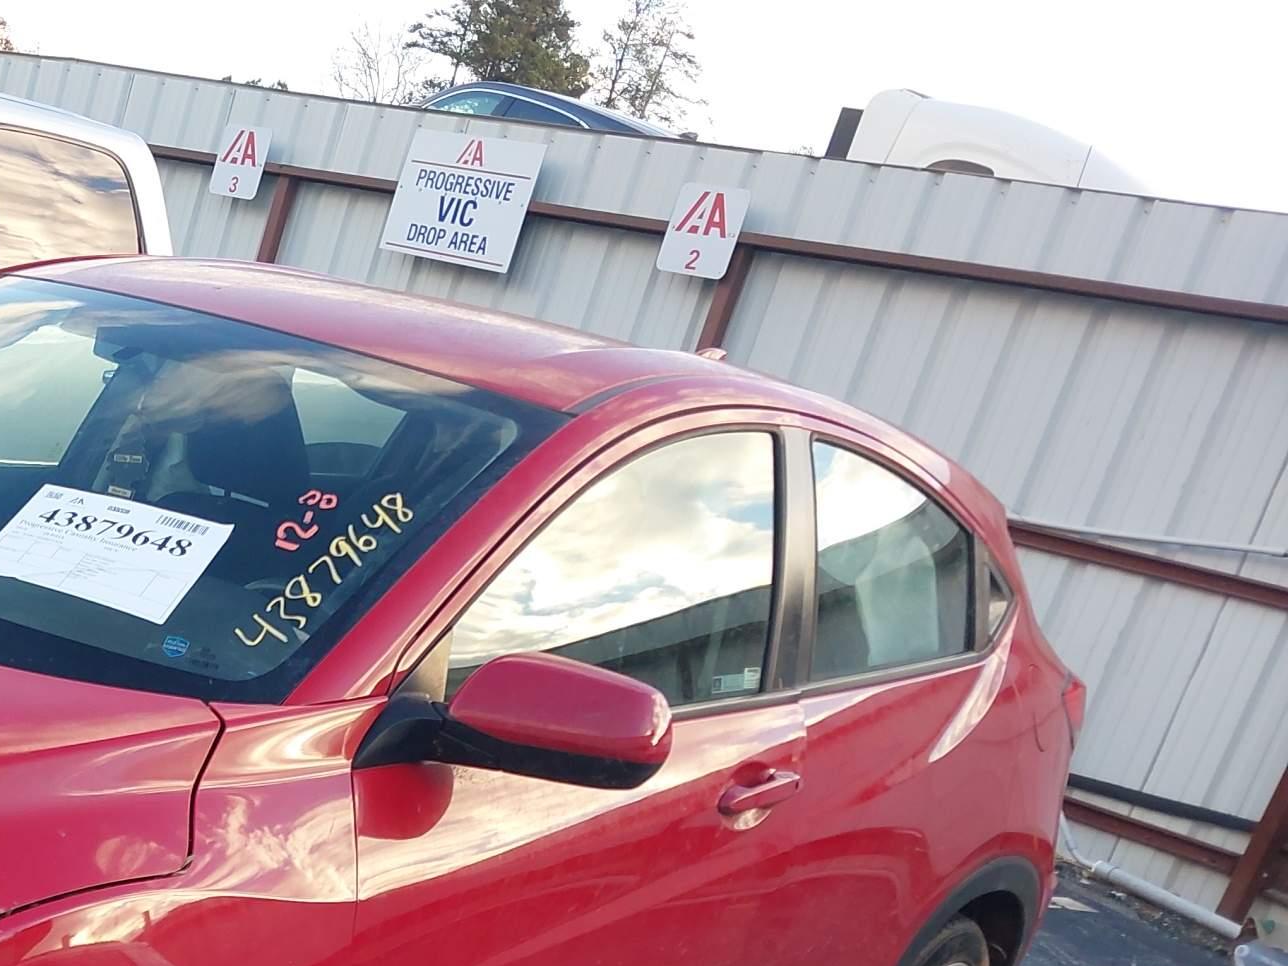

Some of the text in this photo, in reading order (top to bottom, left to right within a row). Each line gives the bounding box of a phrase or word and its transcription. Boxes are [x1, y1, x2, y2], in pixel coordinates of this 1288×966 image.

[228, 176, 239, 193] 3
[416, 168, 516, 202] PROGRESSIVE
[438, 195, 478, 228] VIC
[406, 223, 488, 256] DROP AREA
[684, 249, 701, 270] 2
[37, 507, 194, 558] 43879648
[233, 491, 414, 647] 43879648
